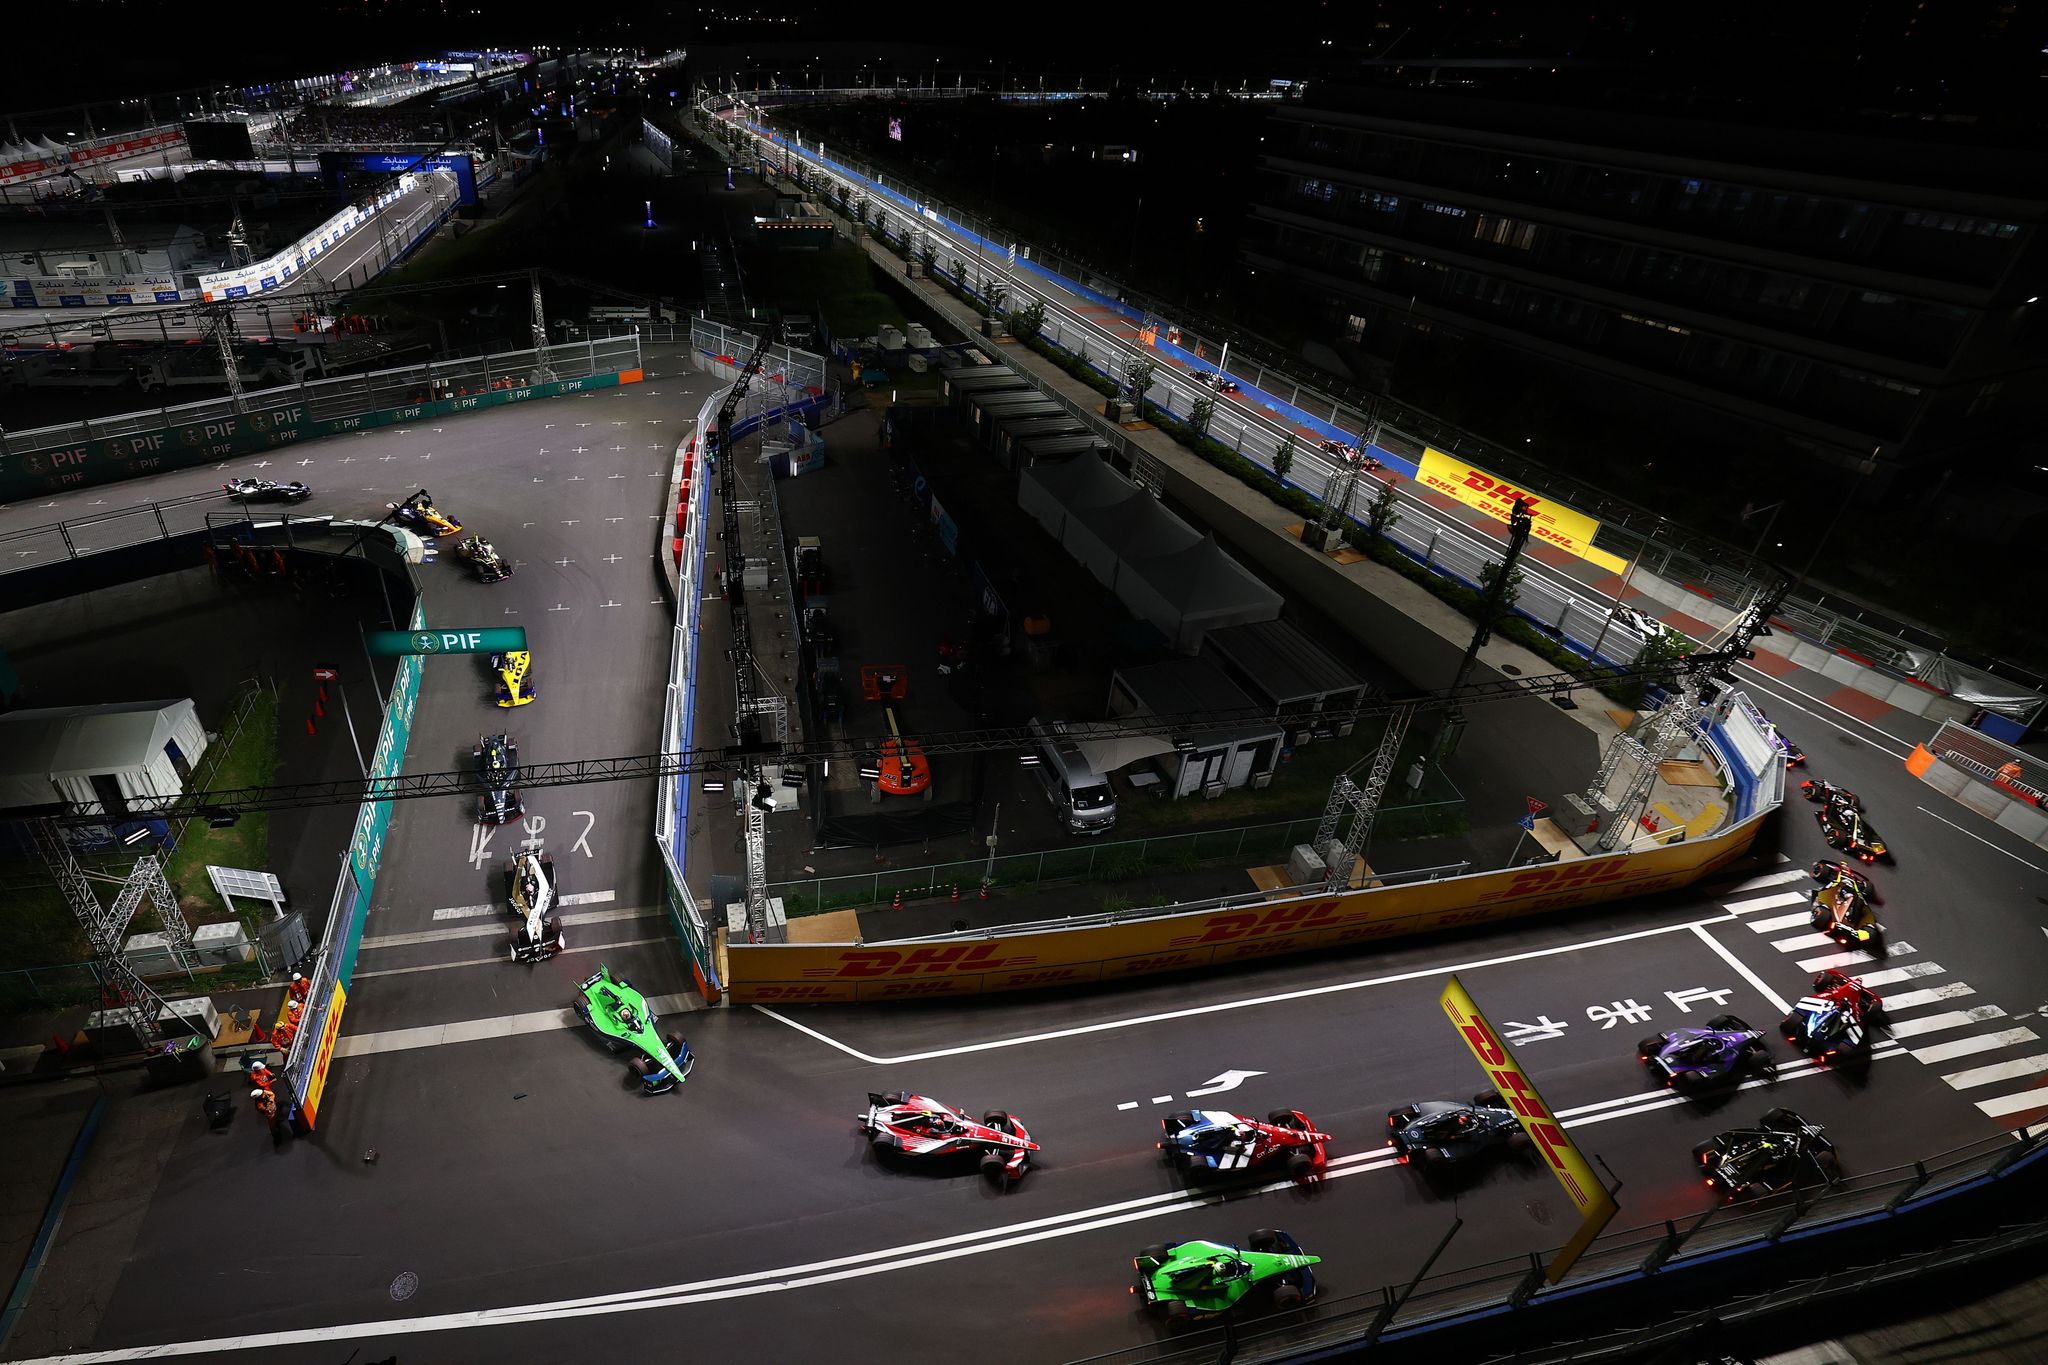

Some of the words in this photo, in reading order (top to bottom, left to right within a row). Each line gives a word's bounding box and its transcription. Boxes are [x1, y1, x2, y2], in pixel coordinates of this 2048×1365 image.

[517, 389, 532, 399] PIF
[568, 381, 583, 391] PIF
[405, 407, 421, 418] PIF
[462, 398, 478, 408] PIF
[272, 407, 303, 426] PIF
[343, 417, 361, 429] PIF
[204, 421, 236, 439] PIF
[280, 429, 299, 441] PIF
[130, 434, 165, 453] PIF
[212, 444, 232, 455] PIF
[50, 448, 88, 468] PIF
[139, 458, 160, 469] PIF
[61, 472, 83, 484] PIF
[1425, 475, 1457, 495] DHL
[1463, 470, 1541, 516] DHL
[1535, 526, 1575, 549] DHL
[441, 633, 481, 650] PIF
[401, 660, 410, 699] PIF
[382, 720, 394, 764] PIF
[371, 832, 381, 862] PIF
[1503, 859, 1631, 898] DHL
[1200, 901, 1343, 942] DHL
[836, 943, 1008, 977] DHL
[755, 986, 829, 998] DHL
[1503, 987, 1734, 1046] 止まれ
[318, 1008, 338, 1082] DHL
[1461, 1015, 1568, 1169] DHL
